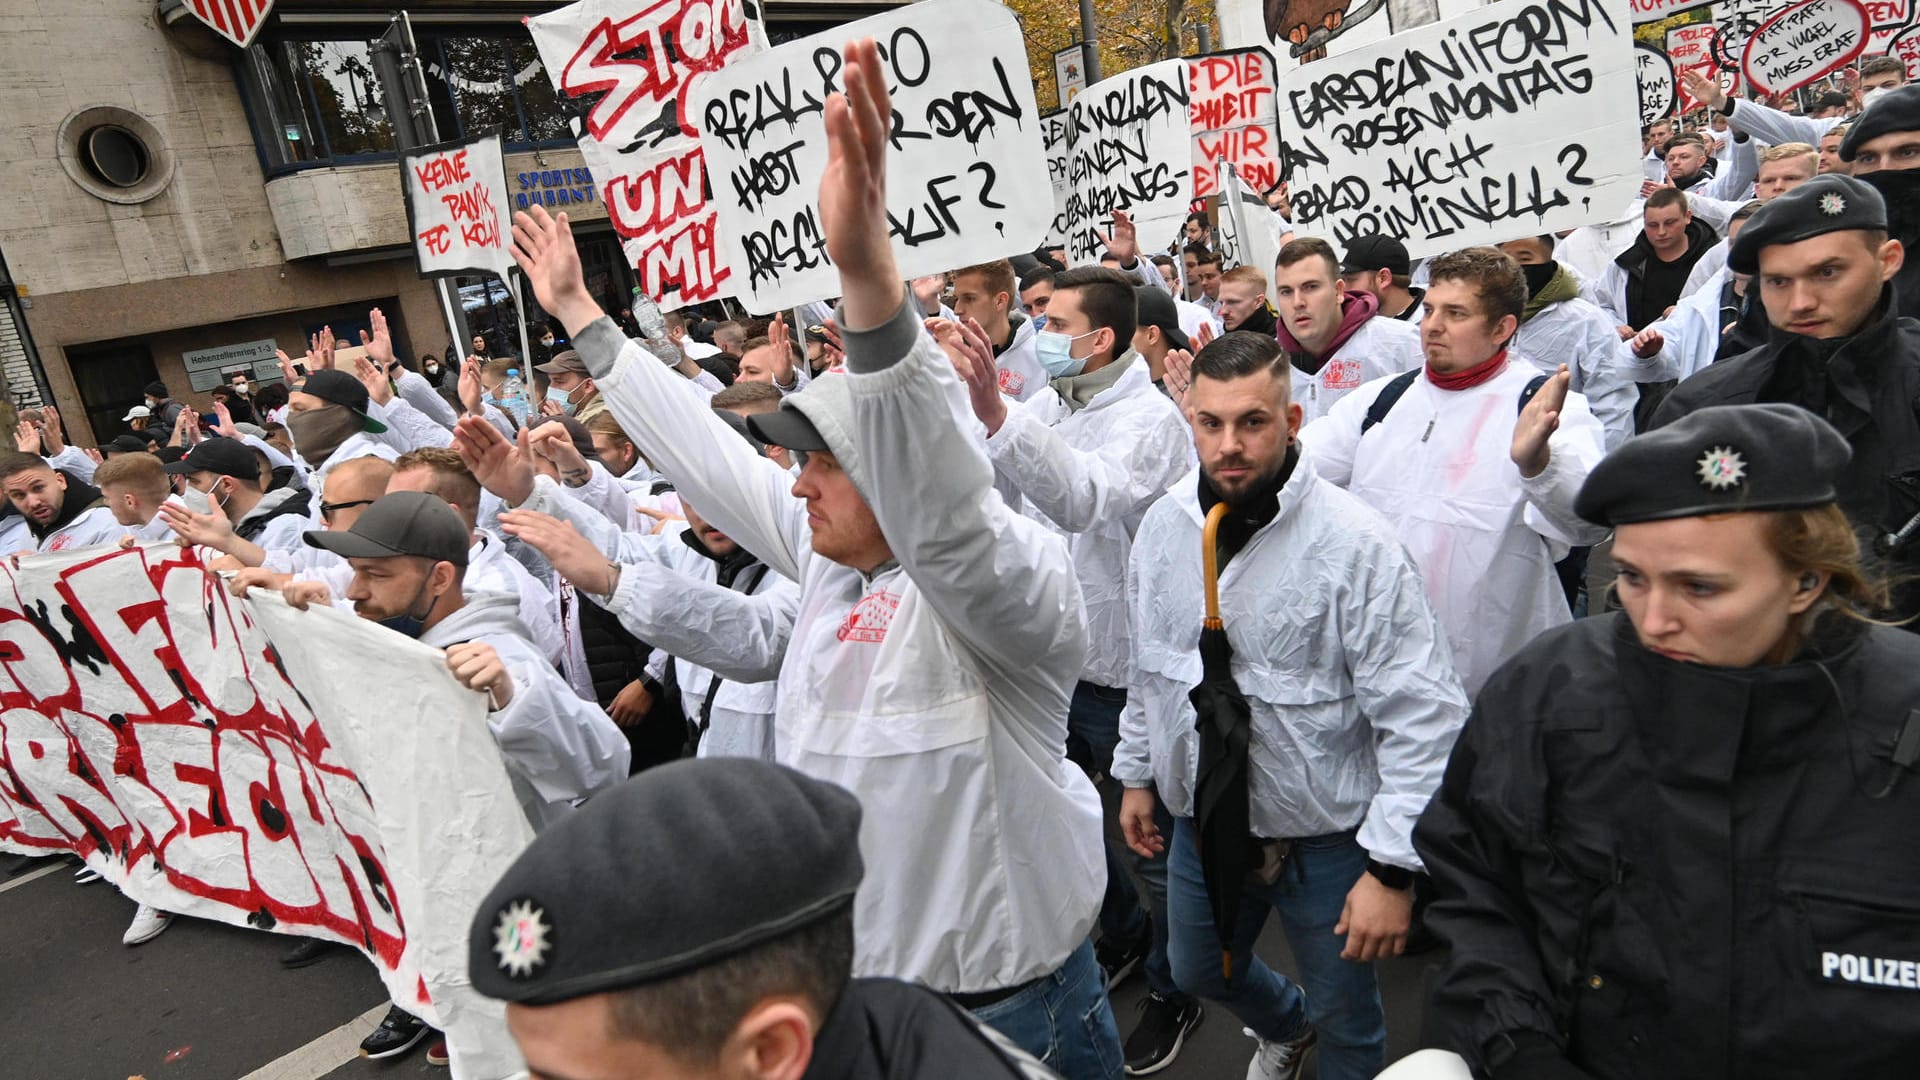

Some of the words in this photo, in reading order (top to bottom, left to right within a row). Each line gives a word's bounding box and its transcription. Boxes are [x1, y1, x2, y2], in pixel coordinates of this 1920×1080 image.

[1199, 53, 1263, 91] DIE
[1767, 56, 1813, 85] MUSS
[1813, 29, 1857, 61] ERAF
[926, 56, 1021, 145] DEN
[1282, 136, 1329, 178] AN
[1331, 54, 1592, 152] ROSENMONTAG
[1198, 125, 1266, 162] WIR
[515, 186, 594, 210] AURANT
[730, 140, 805, 213] HABT
[1292, 176, 1370, 223] BALD
[1383, 134, 1494, 193] AUCH
[418, 223, 450, 257] FC
[191, 347, 257, 365] Hohenzollernring
[258, 344, 272, 353] 1-3
